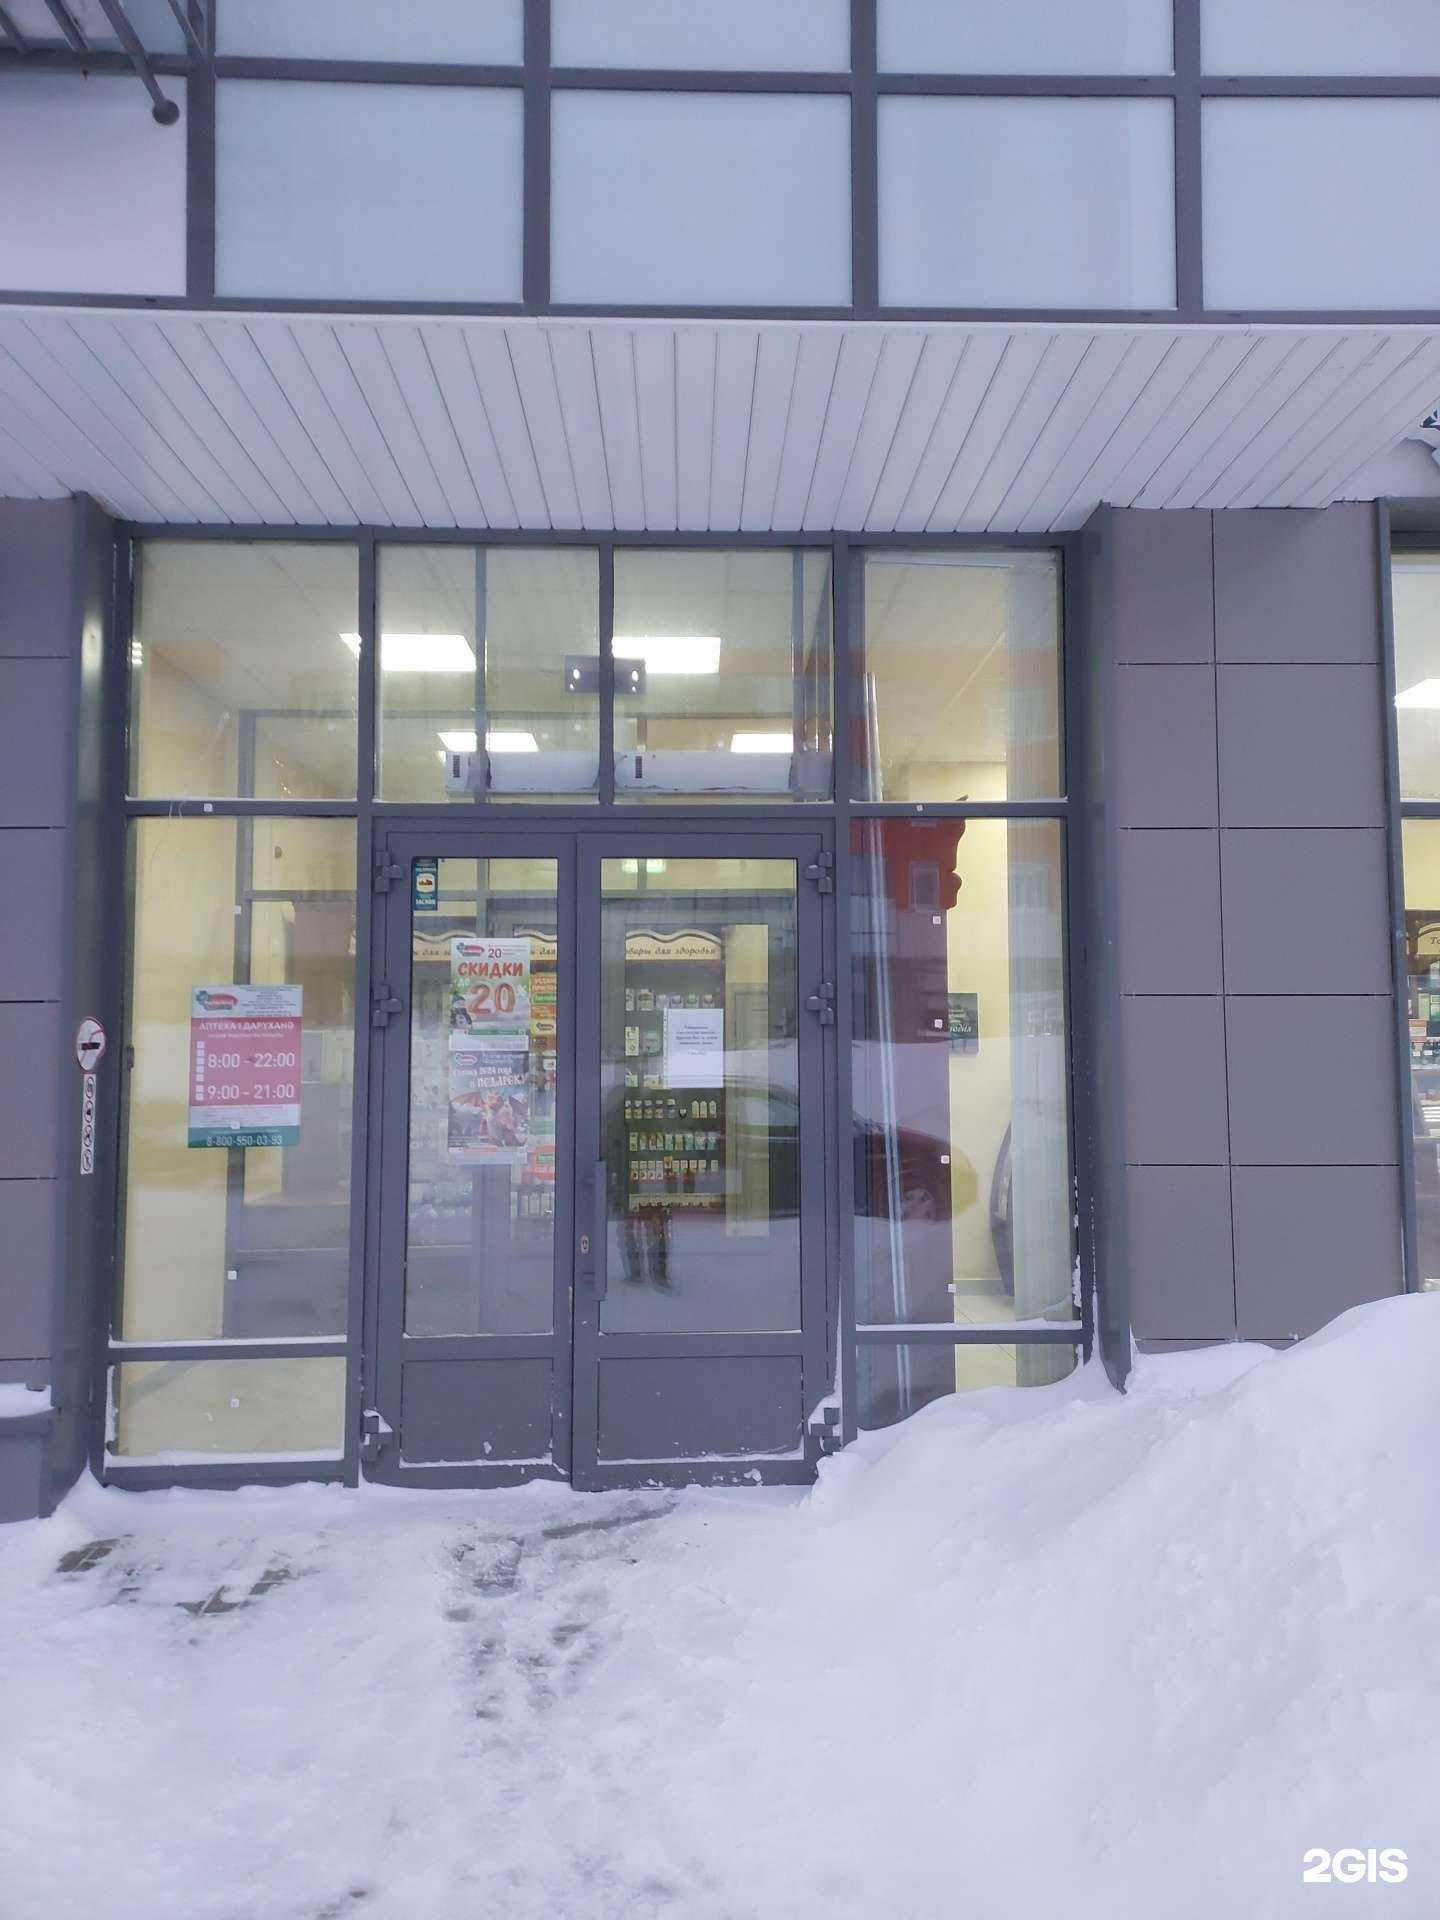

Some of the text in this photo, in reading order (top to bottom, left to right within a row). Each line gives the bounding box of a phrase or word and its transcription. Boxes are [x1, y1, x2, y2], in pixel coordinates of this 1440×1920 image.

[487, 947, 503, 959] 20
[457, 961, 524, 979] СКИДКИ
[207, 1053, 241, 1069] 8:00
[254, 1052, 296, 1068] 22:00
[207, 1085, 240, 1100] 9:00
[253, 1084, 295, 1100] 21:00
